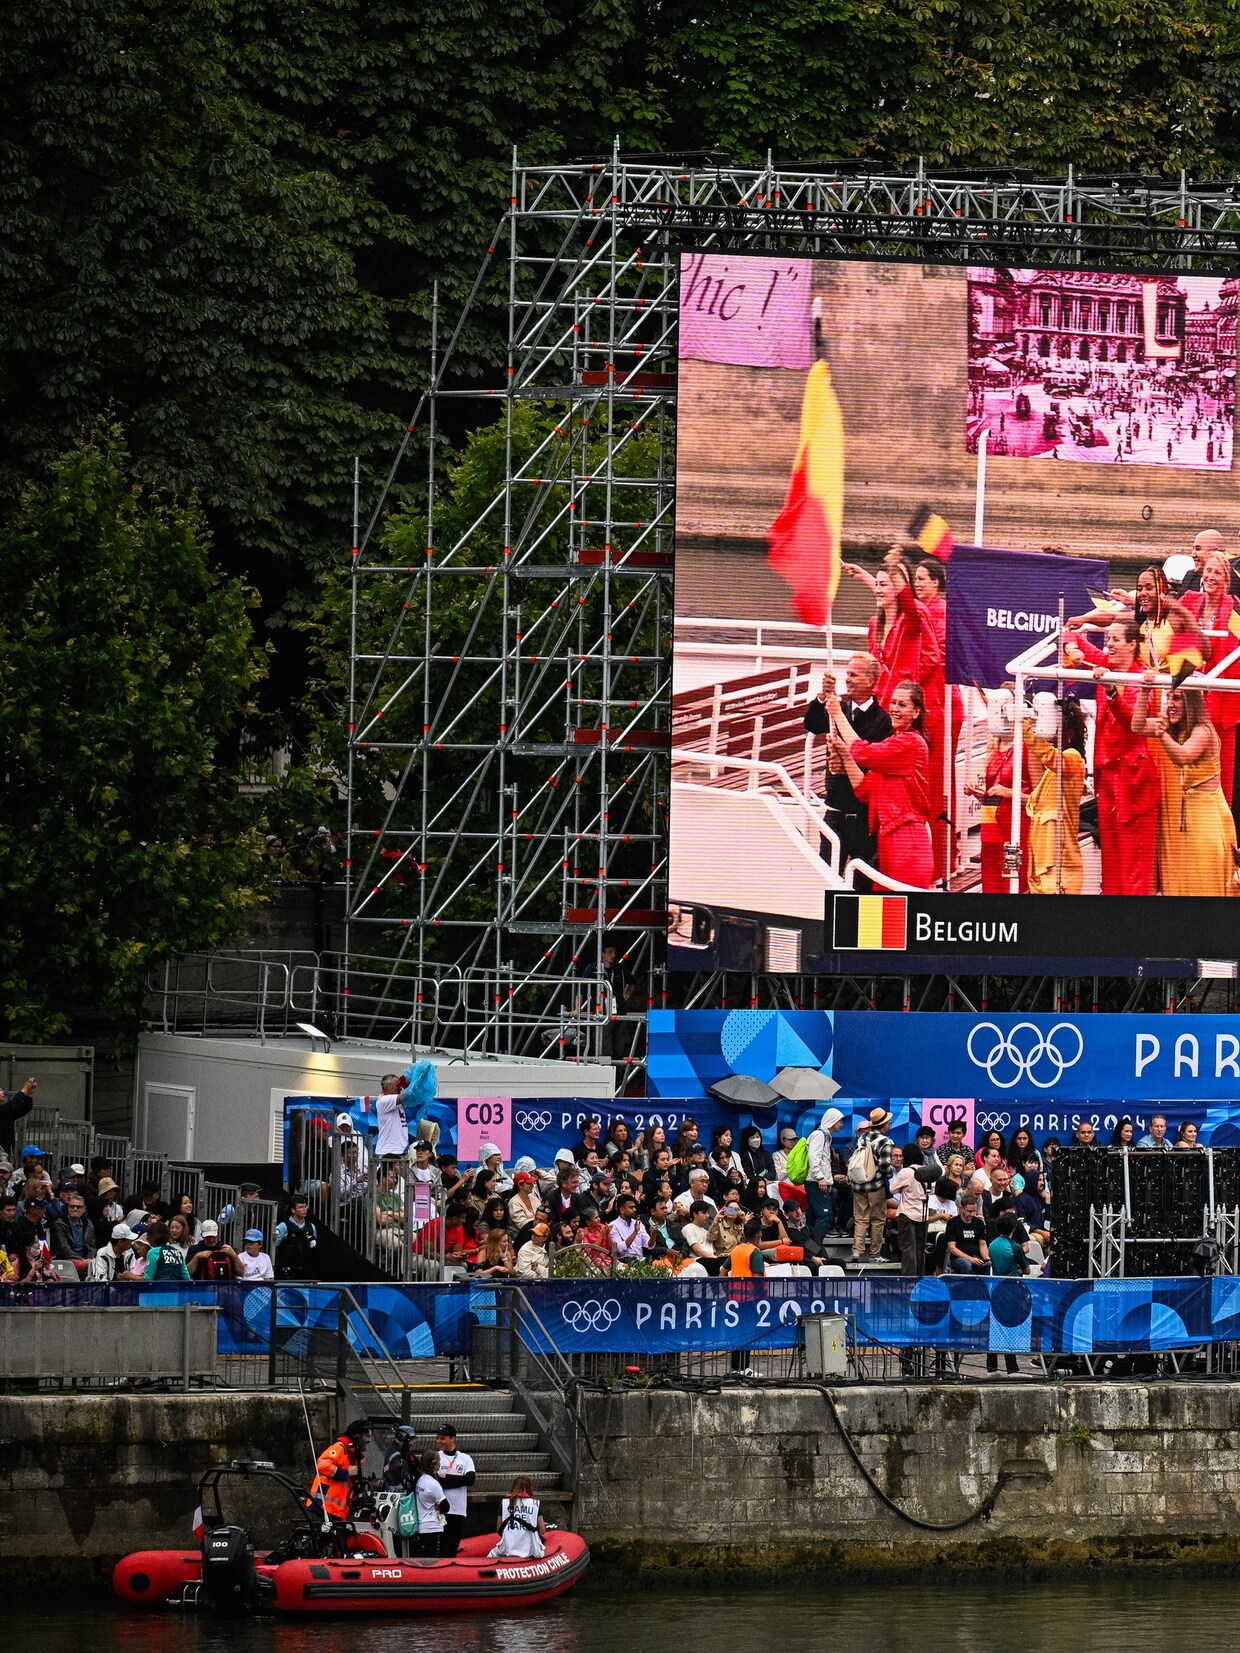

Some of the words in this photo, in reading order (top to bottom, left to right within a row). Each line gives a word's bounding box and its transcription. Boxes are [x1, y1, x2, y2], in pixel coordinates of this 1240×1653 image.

[1142, 281, 1182, 359] L
[986, 607, 1061, 634] BELGIUM
[465, 1103, 505, 1126] C03
[929, 1104, 968, 1126] C02
[509, 1505, 534, 1515] AMU
[371, 1569, 402, 1579] PRO
[495, 1562, 550, 1580] PROTECTION
[547, 1552, 570, 1571] CIVILE
